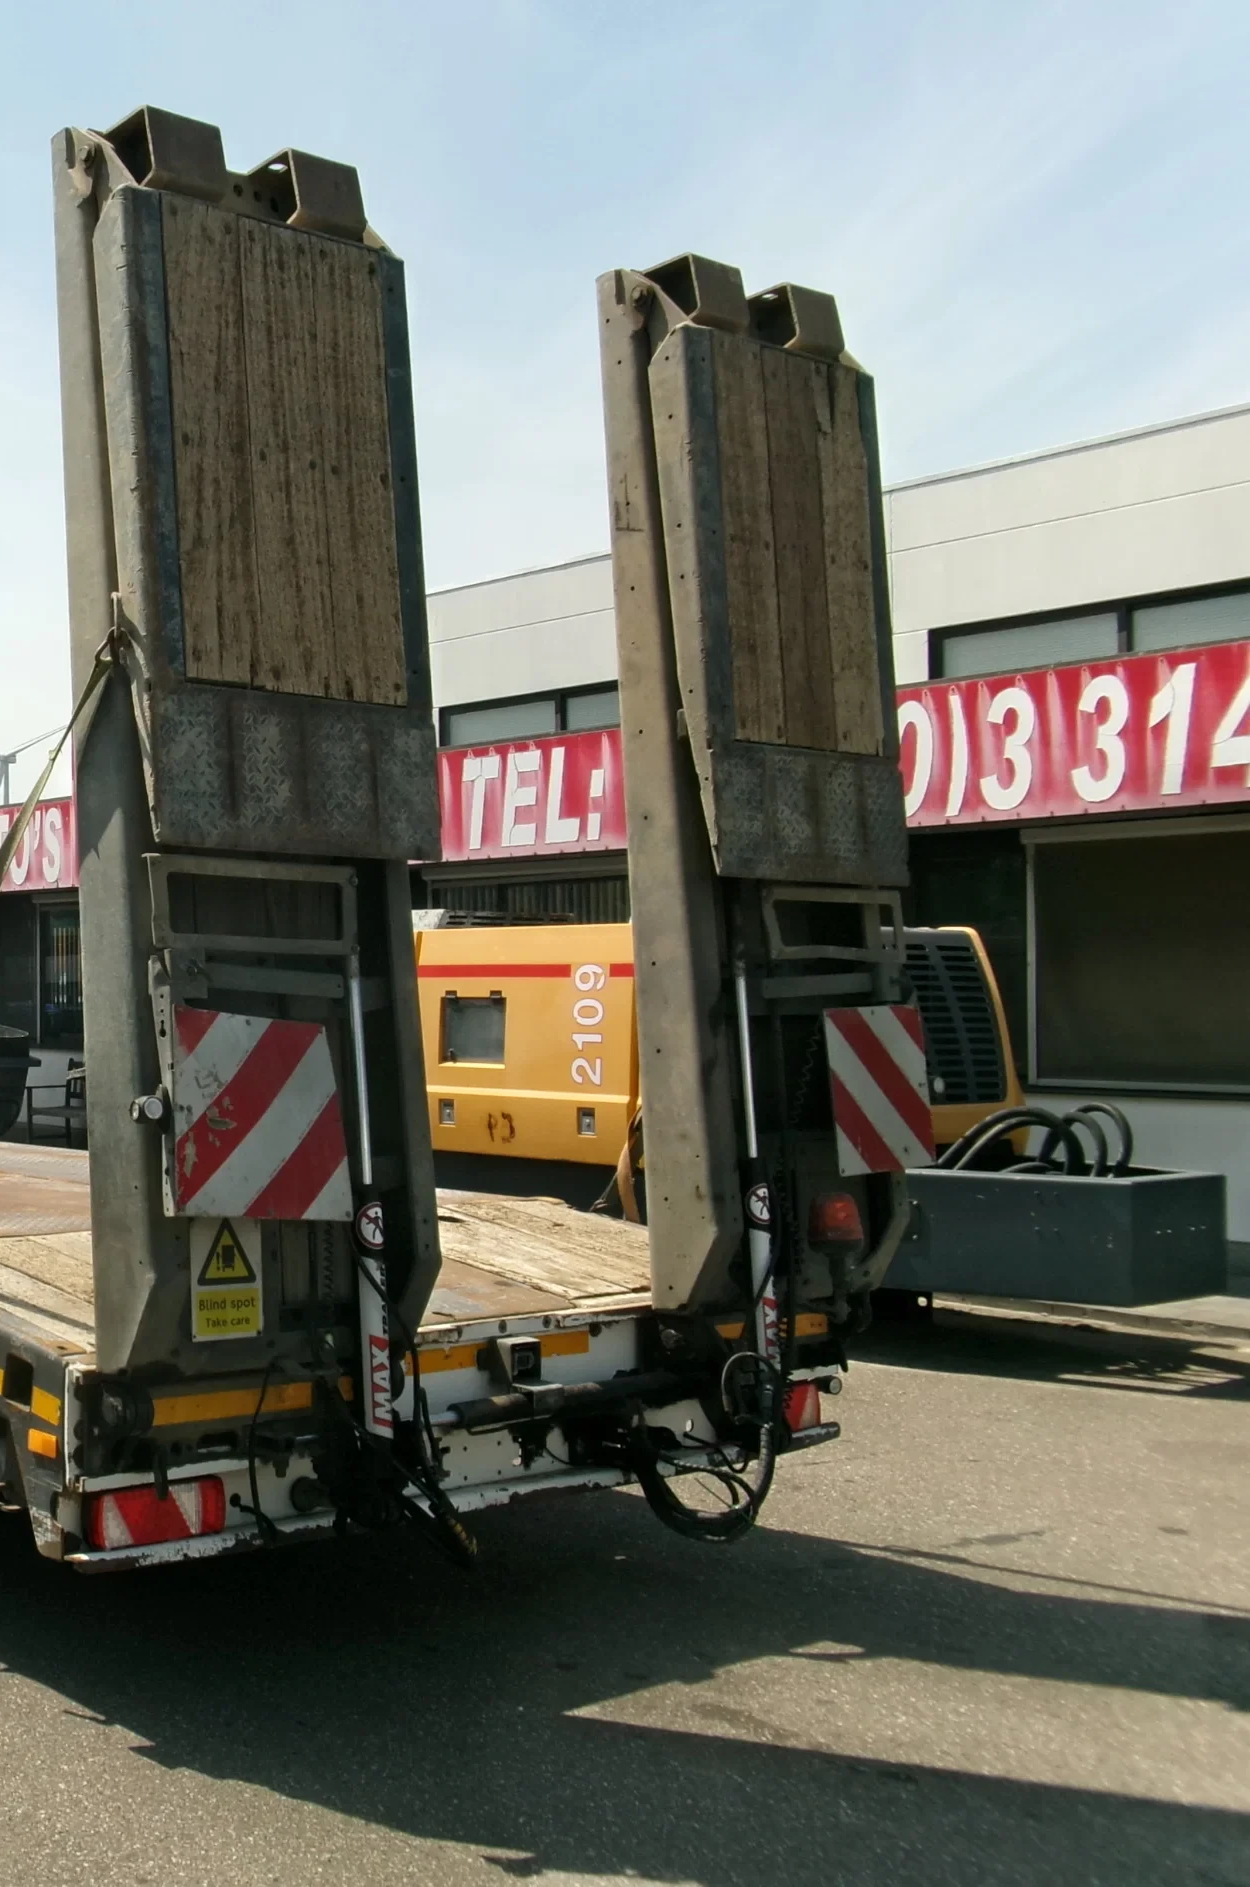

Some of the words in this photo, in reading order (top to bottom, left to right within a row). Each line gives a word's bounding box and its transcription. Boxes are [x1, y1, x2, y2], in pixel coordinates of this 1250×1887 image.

[462, 746, 605, 850] TEL:
[570, 963, 606, 1087] 2109
[199, 1297, 227, 1311] Blind
[231, 1296, 256, 1311] spot
[206, 1317, 228, 1328] Take
[230, 1316, 251, 1326] care
[370, 1344, 394, 1422] MAX
